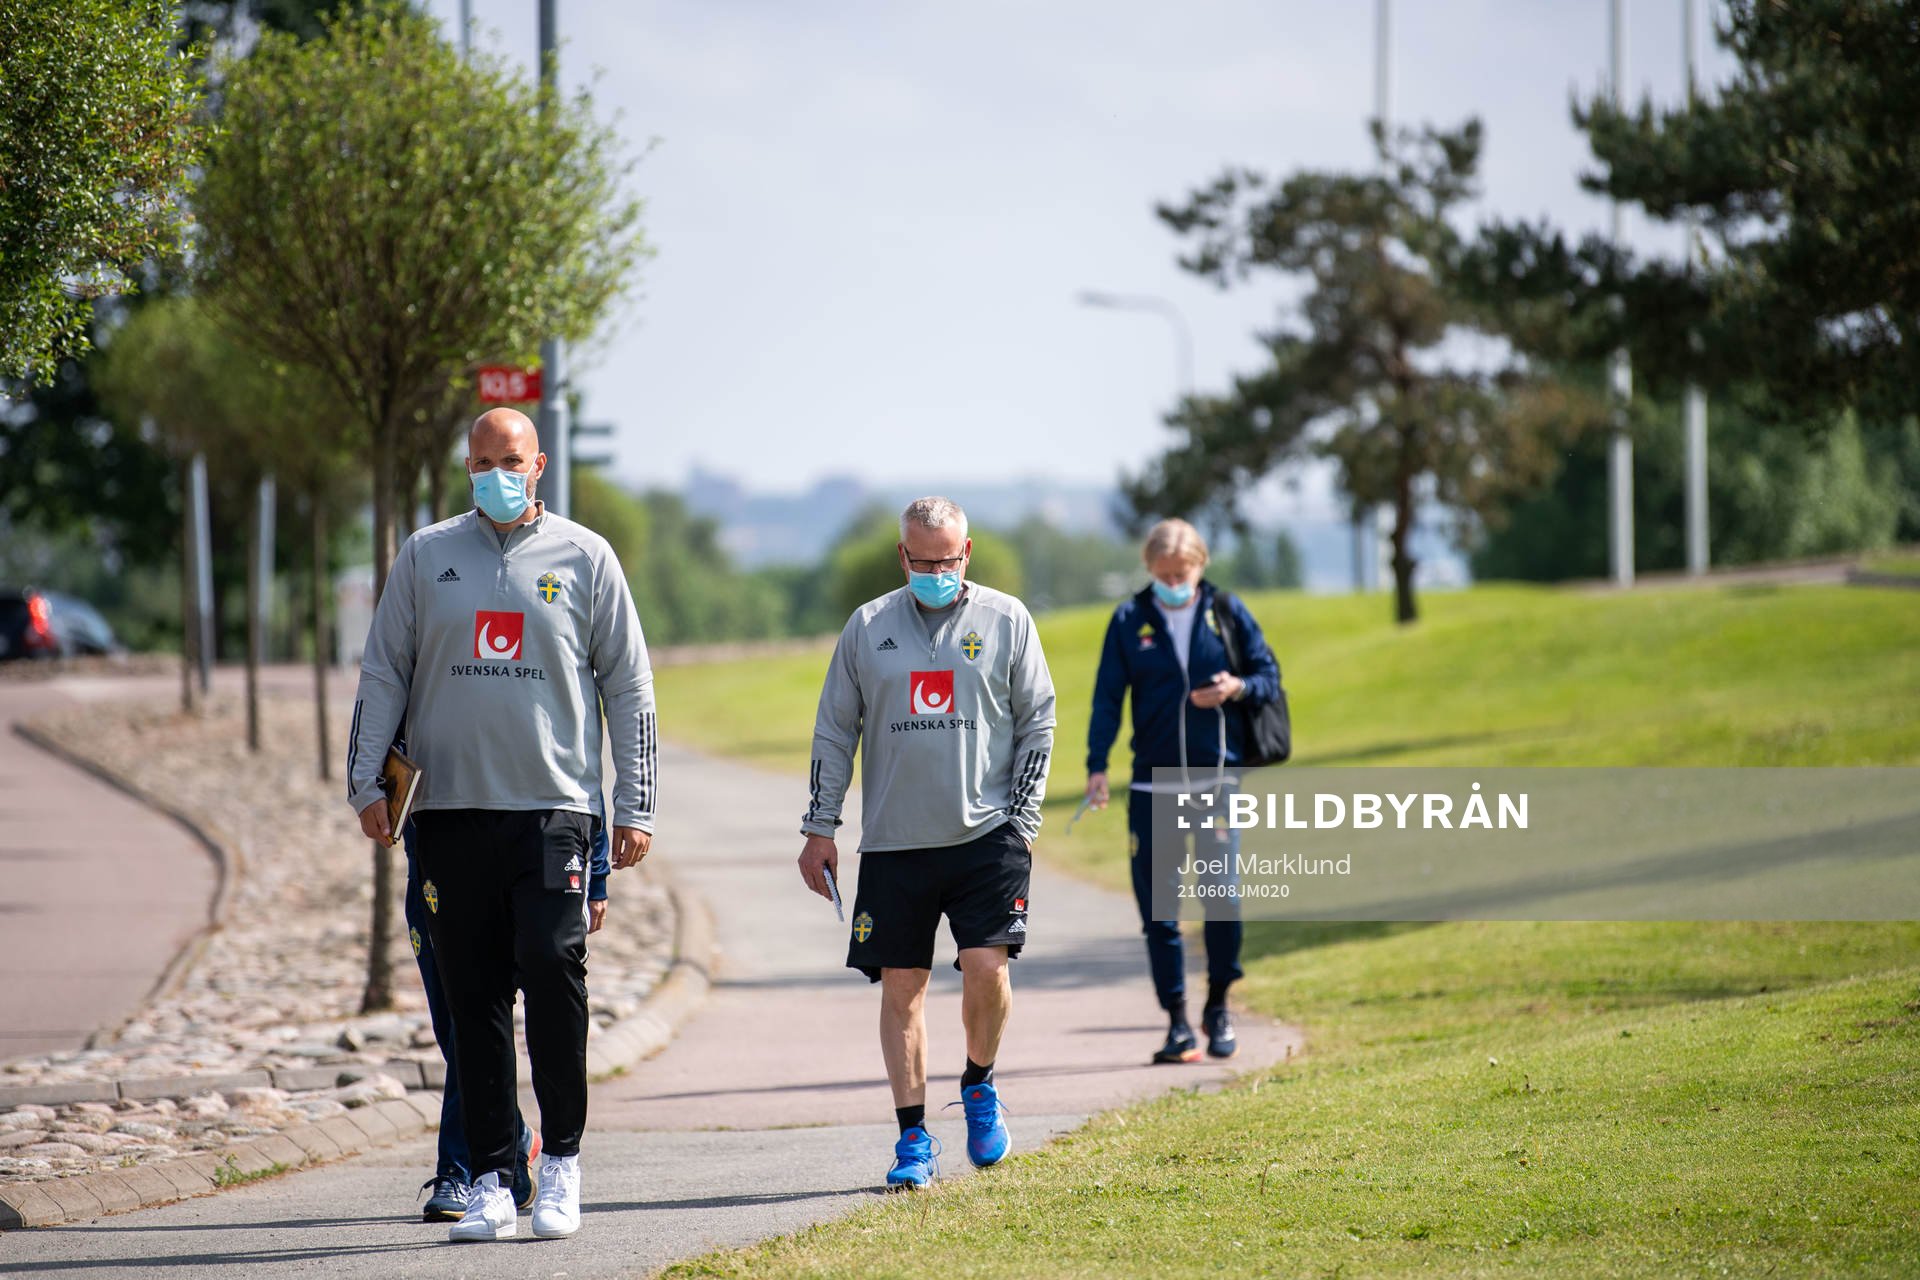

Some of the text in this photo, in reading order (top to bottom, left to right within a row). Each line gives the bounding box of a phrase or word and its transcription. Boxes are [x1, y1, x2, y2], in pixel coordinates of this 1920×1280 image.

[451, 665, 546, 681] SVENSKA SPEL
[890, 719, 977, 733] SVENSKA SPEL
